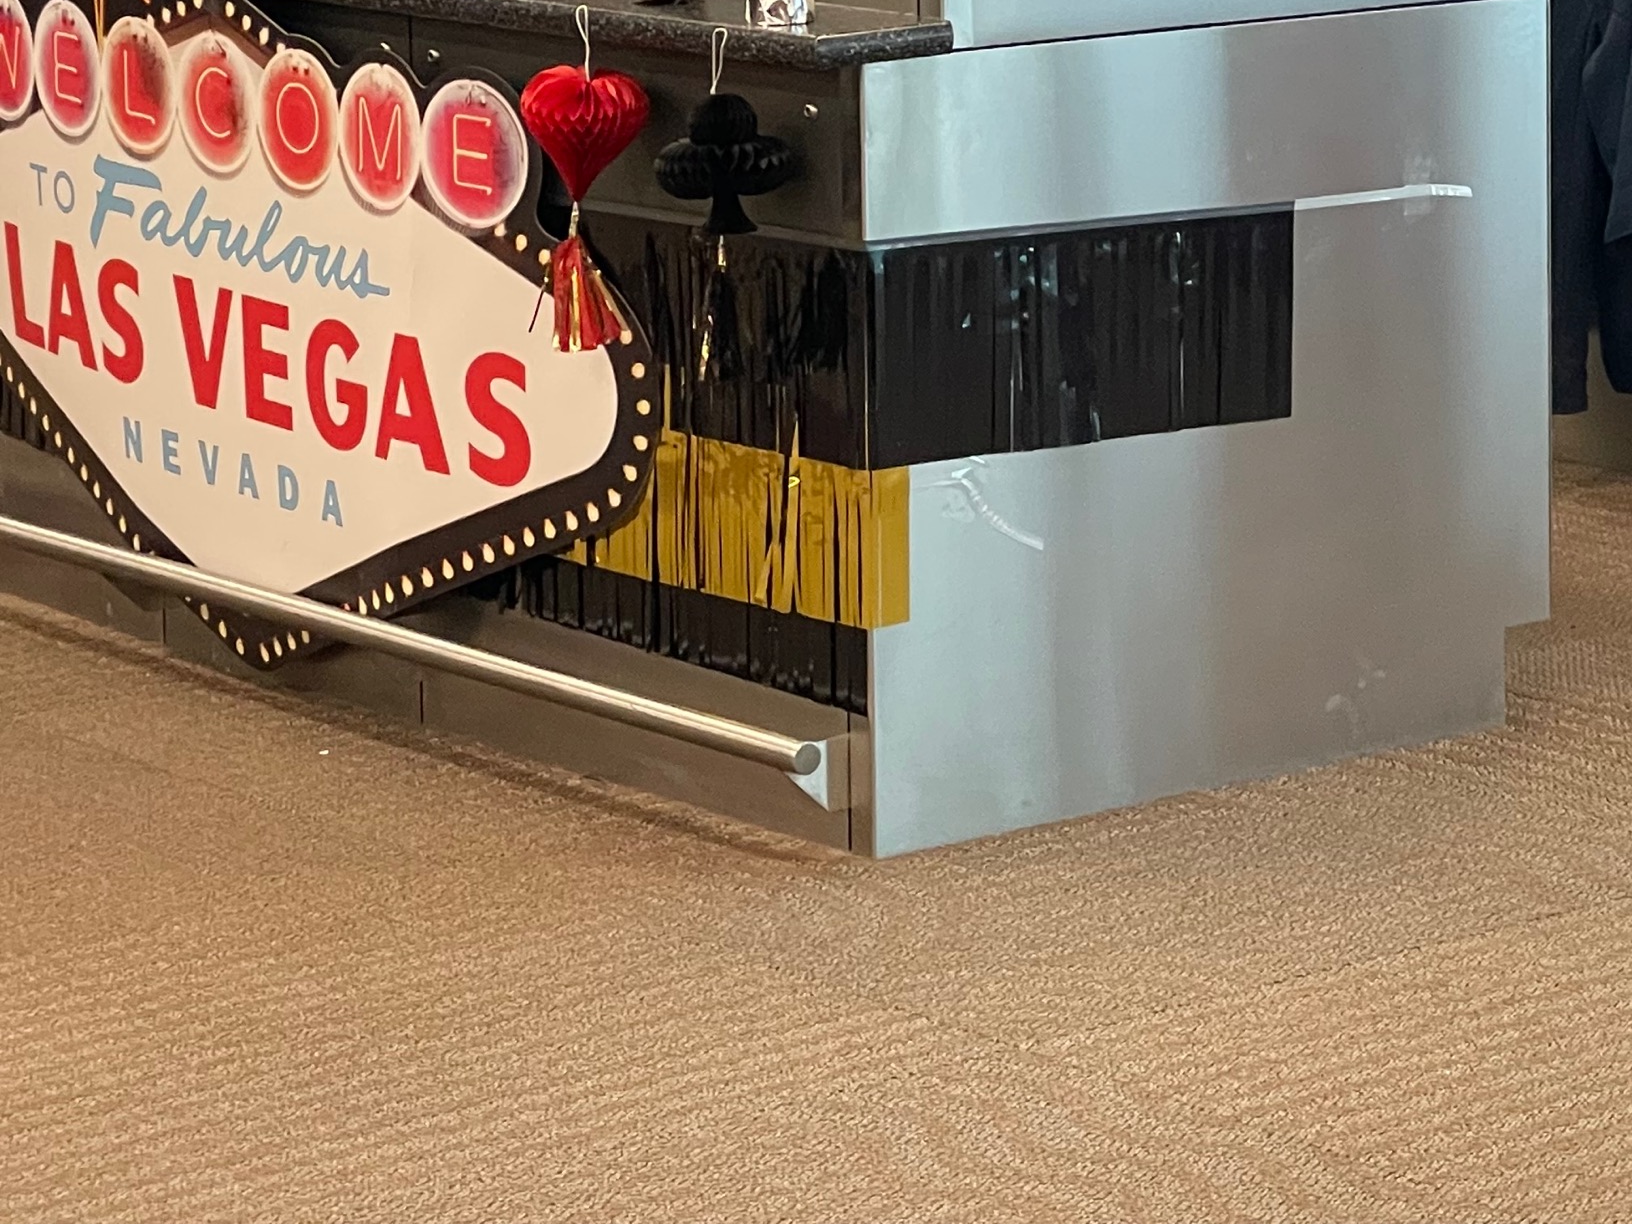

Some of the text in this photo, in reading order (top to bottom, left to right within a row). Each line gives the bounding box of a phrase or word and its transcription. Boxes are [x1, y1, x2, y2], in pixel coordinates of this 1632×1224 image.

[29, 153, 391, 298] TO Fabulous
[3, 220, 532, 488] LAS VEGAS
[122, 415, 345, 529] NEVADA
